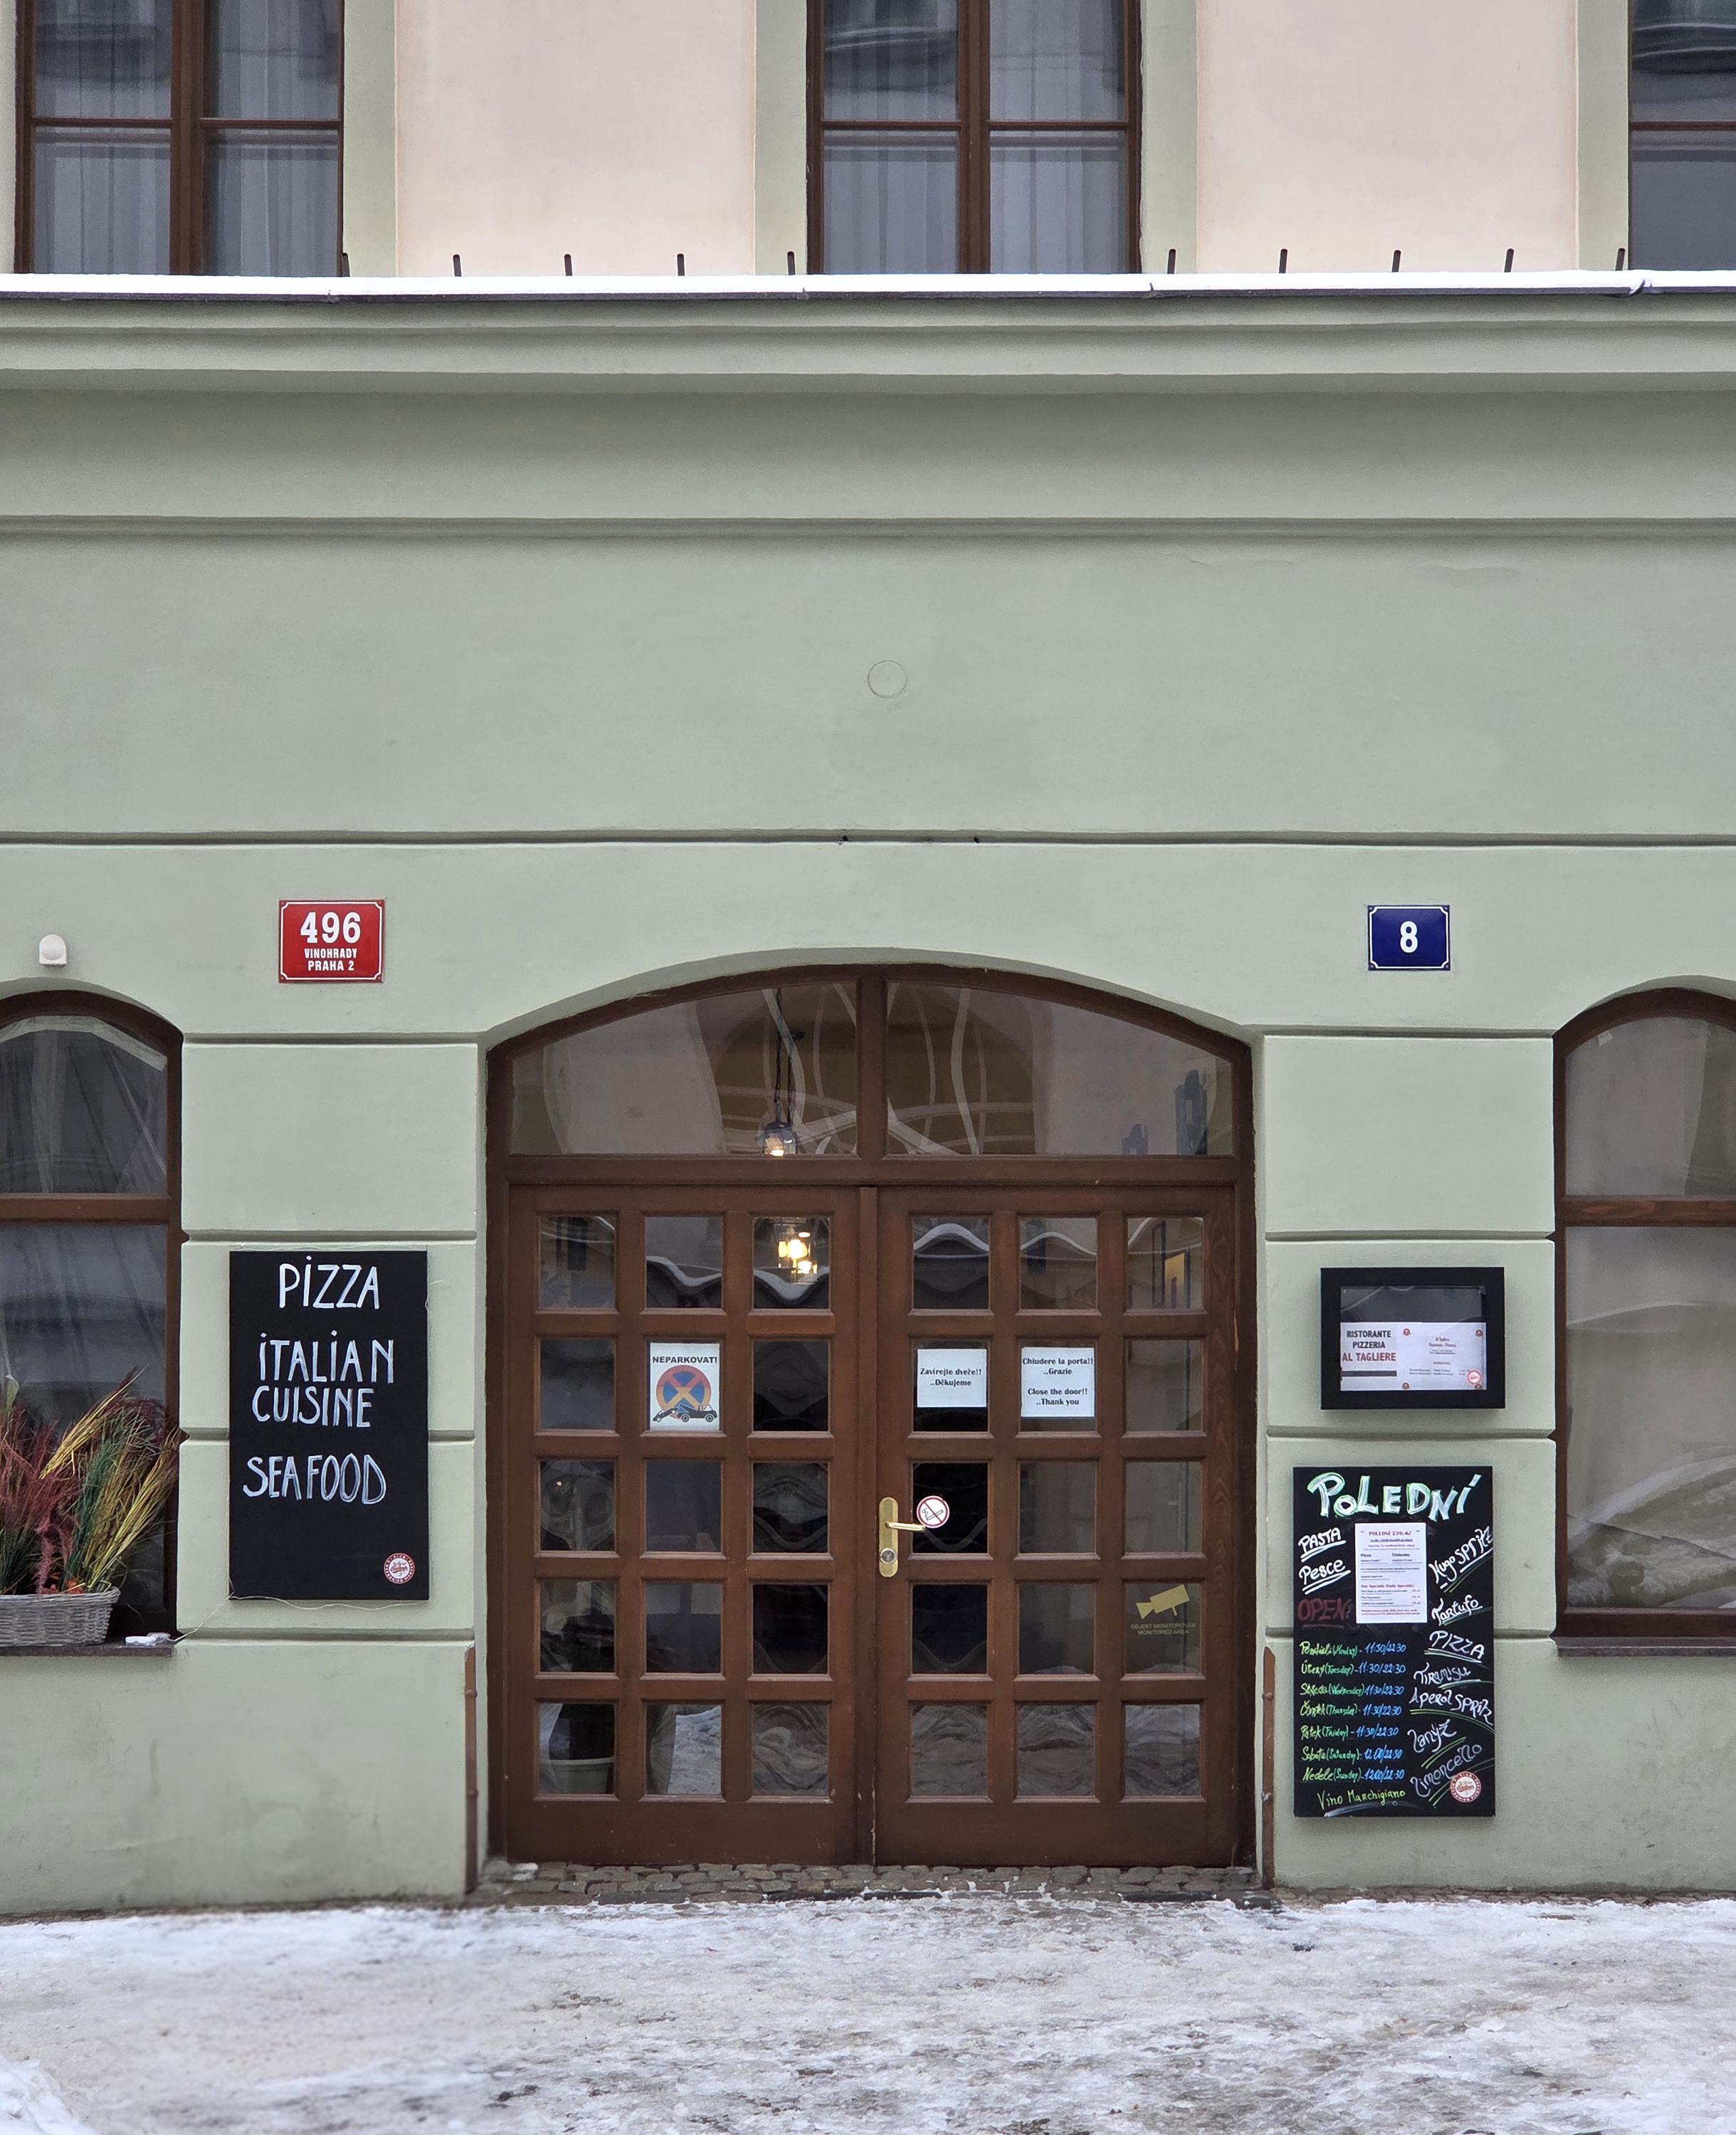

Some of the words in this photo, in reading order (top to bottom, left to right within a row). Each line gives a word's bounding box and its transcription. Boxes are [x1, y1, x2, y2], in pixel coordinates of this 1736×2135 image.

[300, 912, 361, 944] 496
[1400, 921, 1419, 953] 8
[304, 948, 358, 959] VINOHRADY
[307, 961, 344, 971] PRAHA
[348, 961, 354, 971] 2
[1347, 1330, 1392, 1339] RISTORANTE
[1068, 1358, 1093, 1366] porta!!
[1342, 1353, 1353, 1361] AL
[1356, 1353, 1396, 1361] TAGLIERE
[920, 1368, 954, 1376] Zavírejte
[252, 1386, 374, 1428] CUISINE
[1298, 1527, 1342, 1554] PASTA
[1298, 1559, 1346, 1586] Pesce
[1429, 1630, 1485, 1660] PIZZA
[1317, 1789, 1343, 1810] Vino
[1347, 1789, 1406, 1805] Marchigiano
